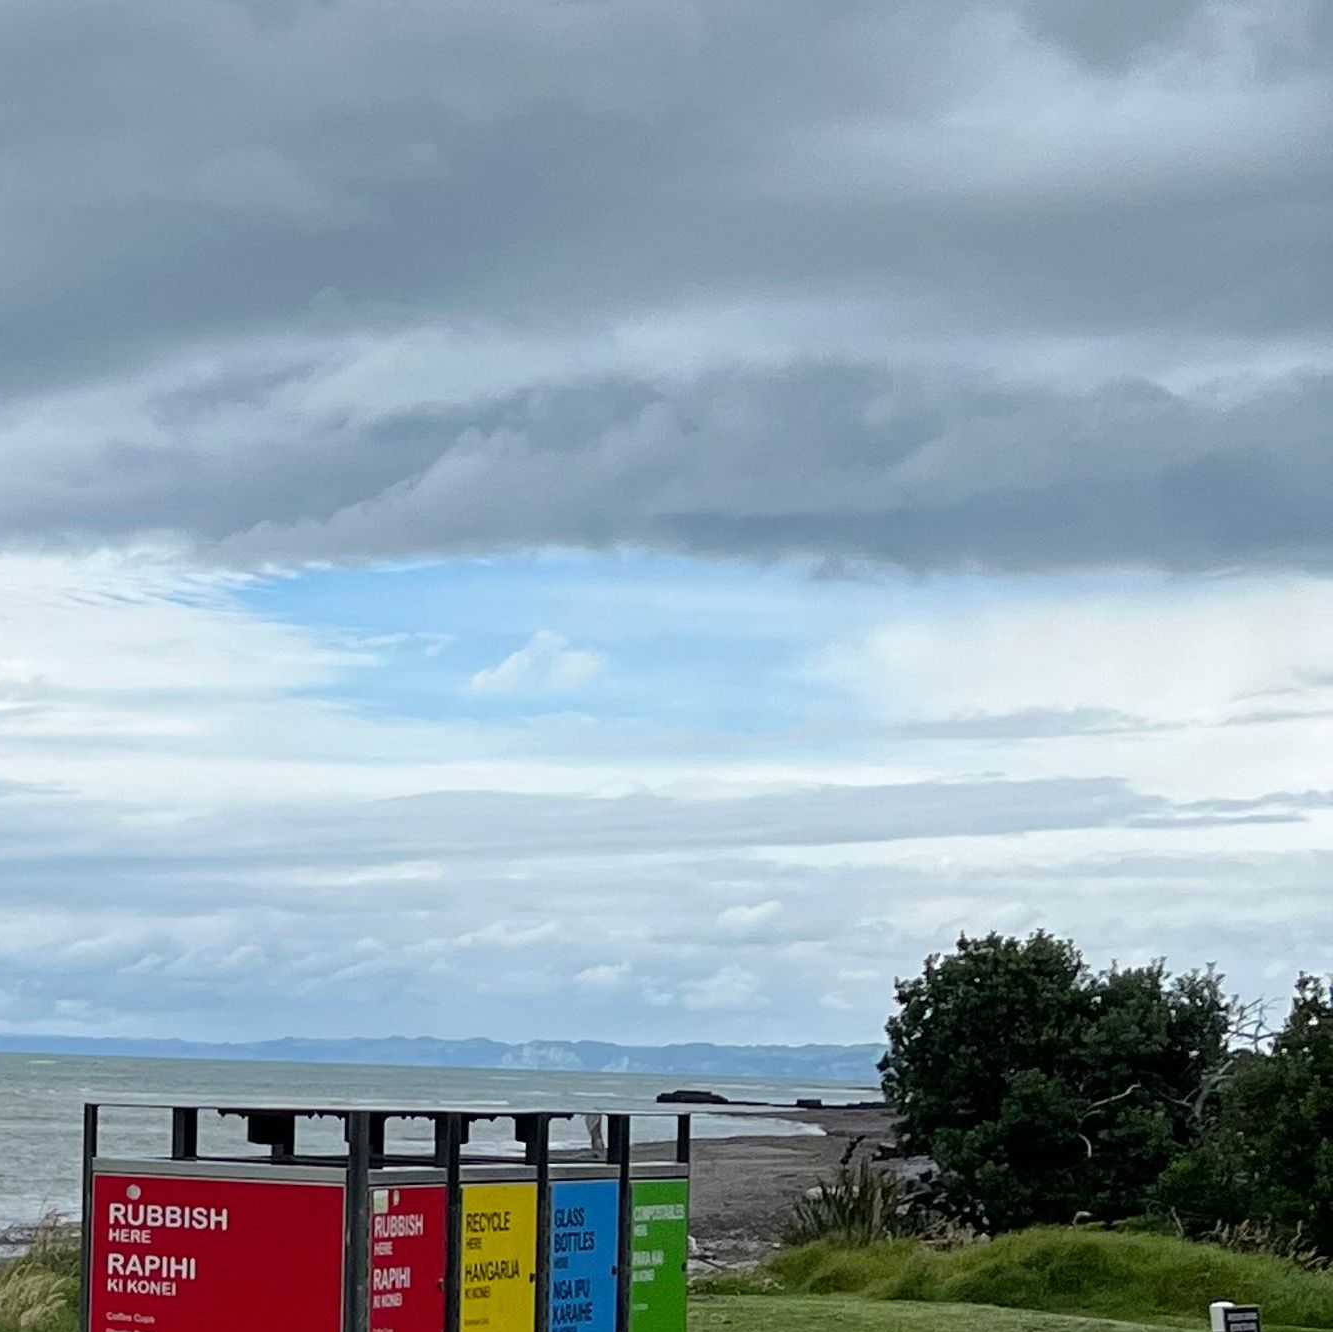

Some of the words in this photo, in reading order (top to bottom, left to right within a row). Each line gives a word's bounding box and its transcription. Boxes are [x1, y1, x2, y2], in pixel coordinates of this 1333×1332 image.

[108, 1203, 228, 1232] RUBBISH
[374, 1213, 424, 1238] RUBBISH
[466, 1211, 511, 1233] RECYCLE
[554, 1207, 585, 1229] GLASS
[108, 1228, 152, 1244] HERE
[554, 1231, 595, 1254] BOTTLES
[107, 1253, 196, 1280] RAPIHI
[464, 1259, 521, 1283] HANGARUA
[107, 1278, 124, 1293] KI
[126, 1279, 177, 1296] KONEI
[372, 1267, 411, 1291] RAPIHI
